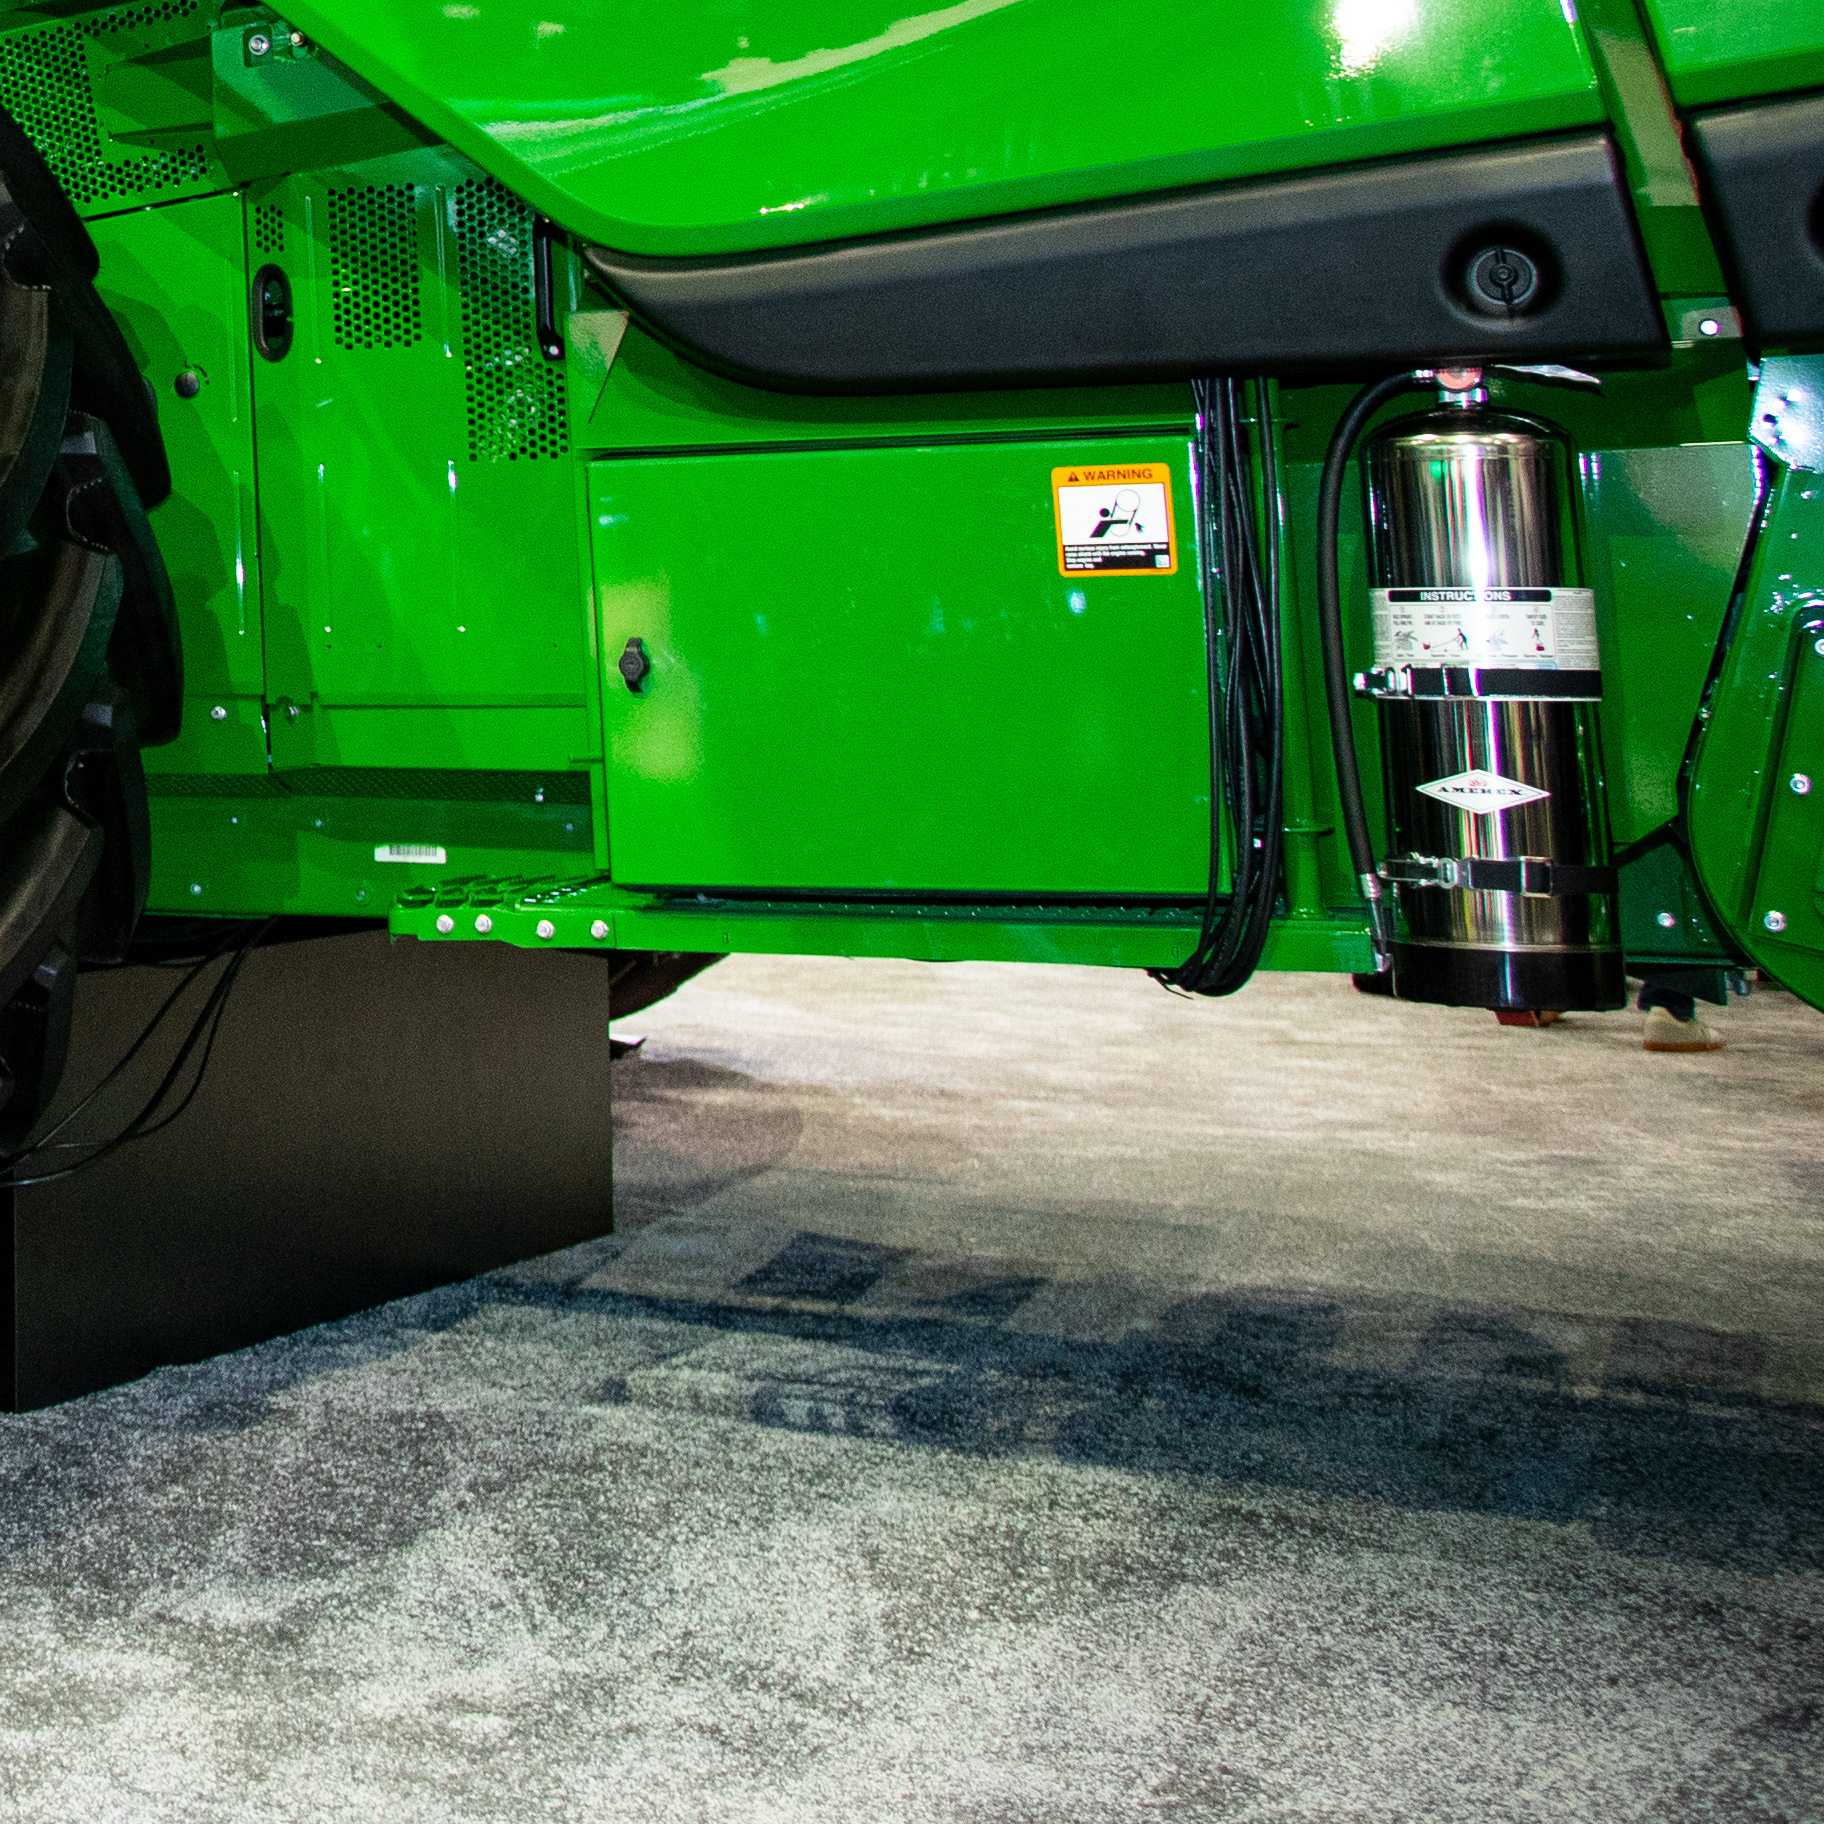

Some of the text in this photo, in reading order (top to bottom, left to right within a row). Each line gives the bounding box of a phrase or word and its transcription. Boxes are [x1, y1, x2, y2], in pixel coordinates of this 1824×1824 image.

[1083, 468, 1153, 481] WARNING
[1420, 590, 1512, 602] INSTRUCONS
[1437, 786, 1523, 796] AMEREX
